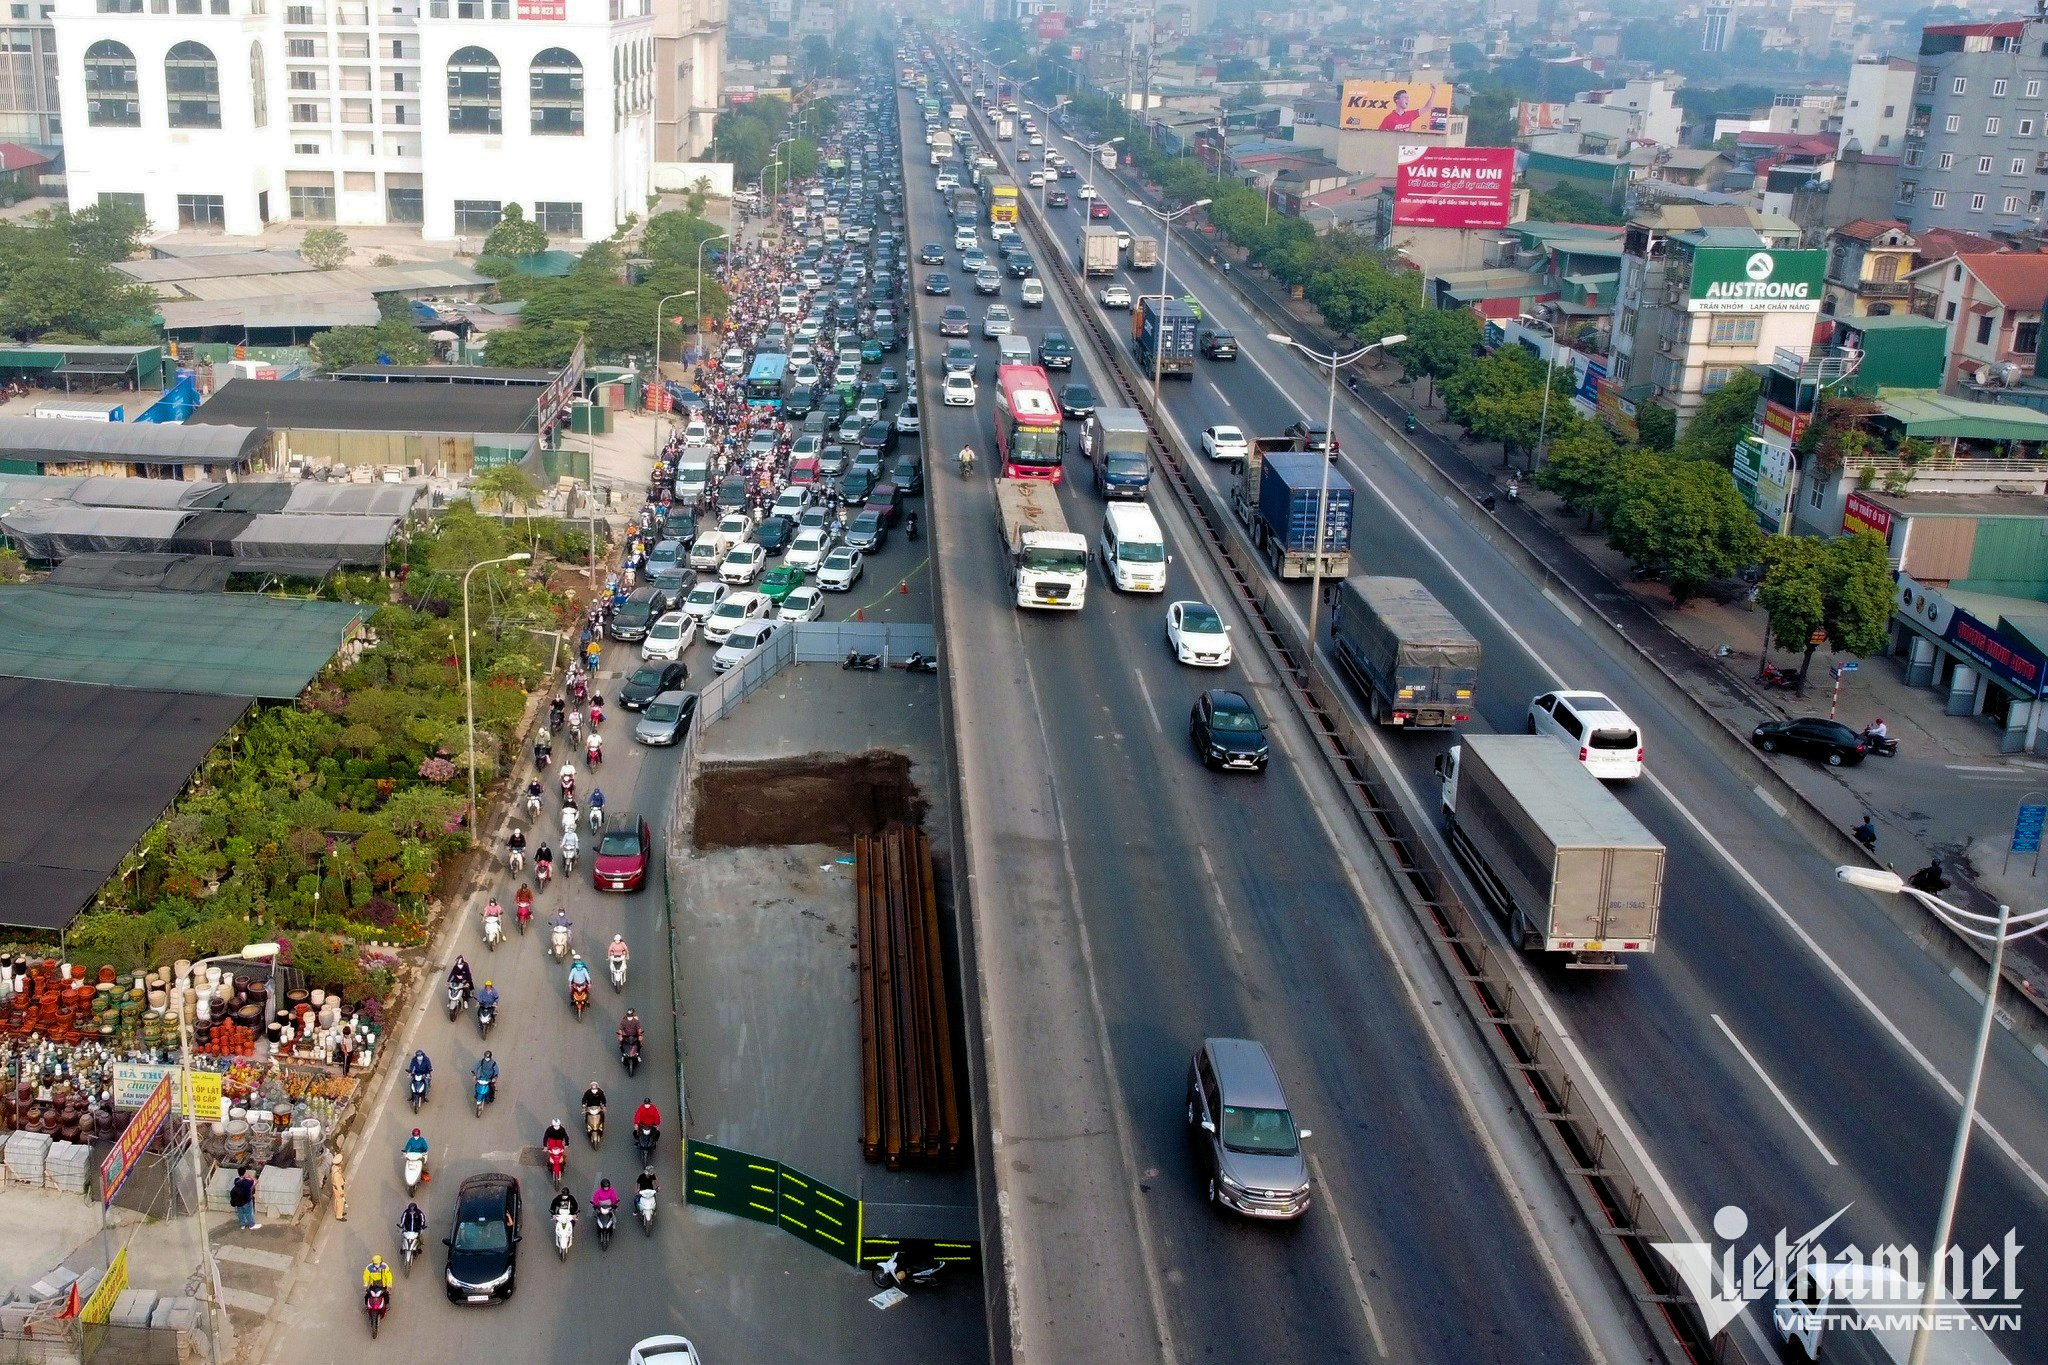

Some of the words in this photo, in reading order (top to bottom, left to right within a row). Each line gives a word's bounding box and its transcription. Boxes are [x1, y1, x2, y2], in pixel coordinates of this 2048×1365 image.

[1348, 96, 1390, 109] Kixx
[1407, 165, 1437, 178] VÁN
[1441, 166, 1471, 179] SÀN
[1476, 168, 1502, 179] UNI
[1706, 282, 1808, 298] AUSTRONG
